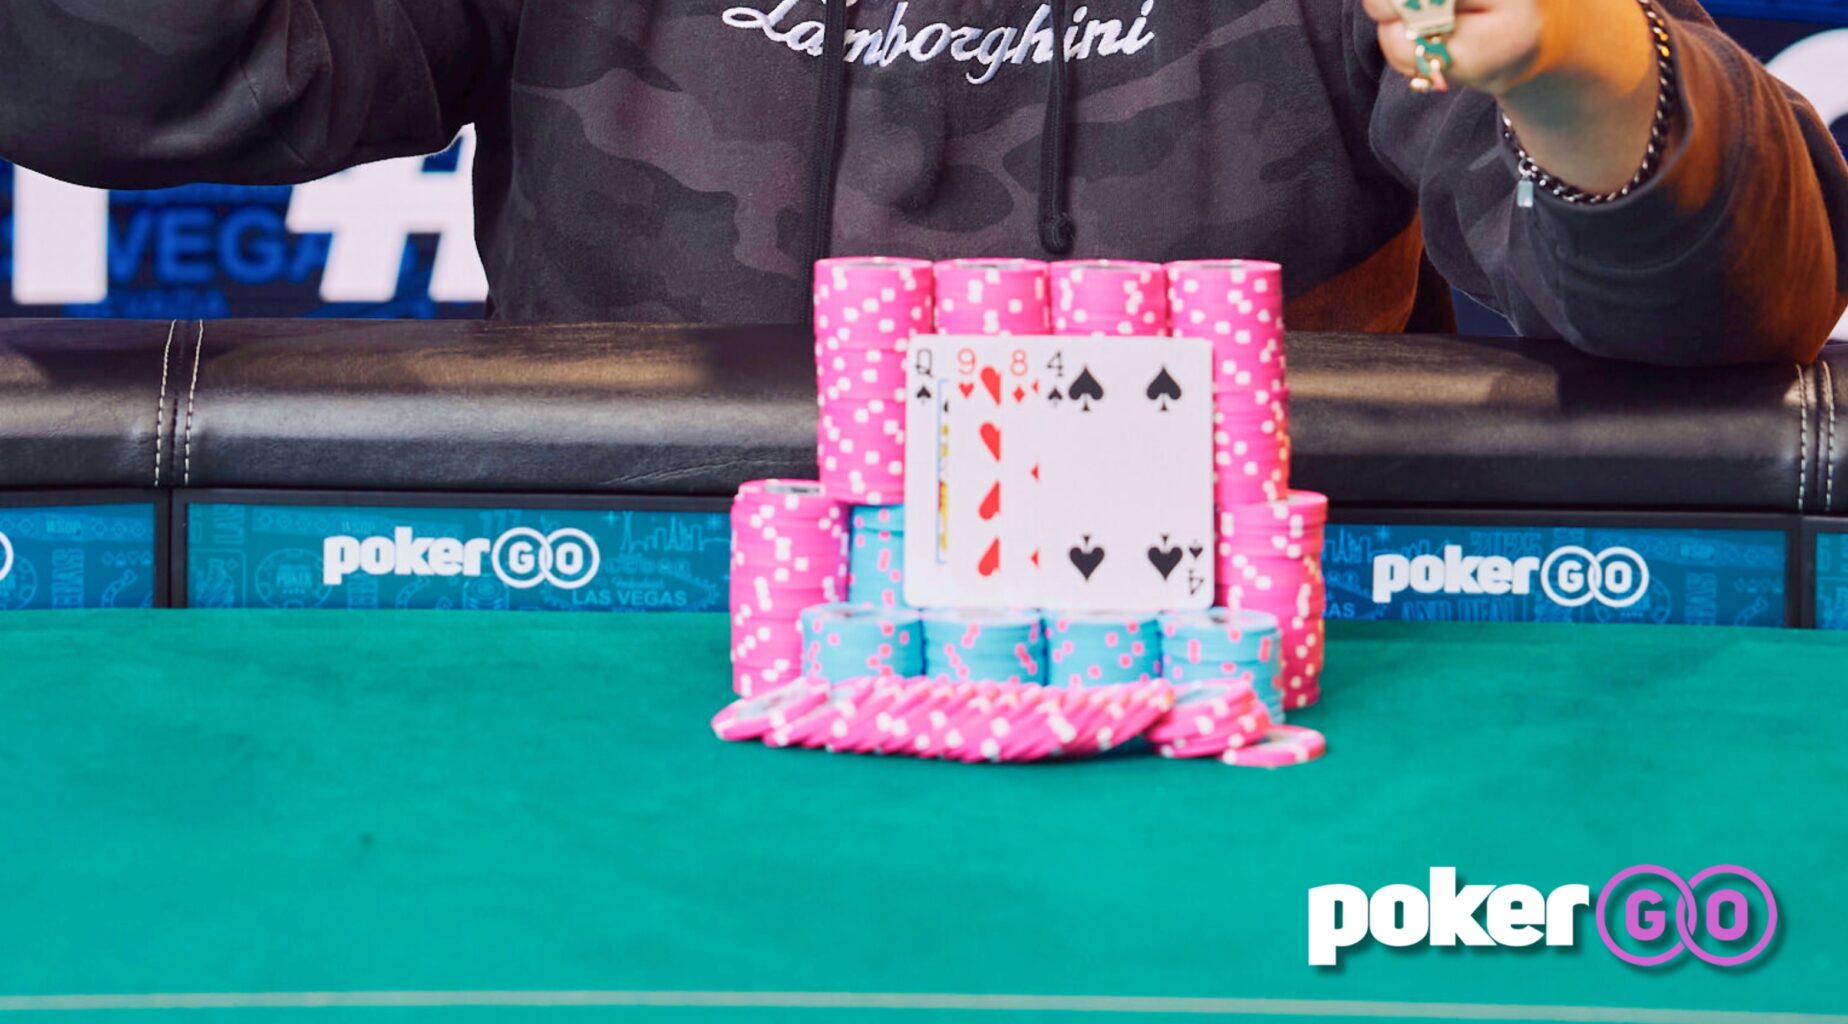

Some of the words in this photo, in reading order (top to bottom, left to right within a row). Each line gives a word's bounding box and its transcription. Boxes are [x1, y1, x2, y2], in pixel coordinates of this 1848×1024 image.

[915, 348, 933, 377] Q
[957, 348, 976, 375] 9
[1010, 349, 1028, 376] 8
[1047, 351, 1063, 377] 4
[572, 589, 612, 606] LAS
[616, 589, 688, 607] VEGAS
